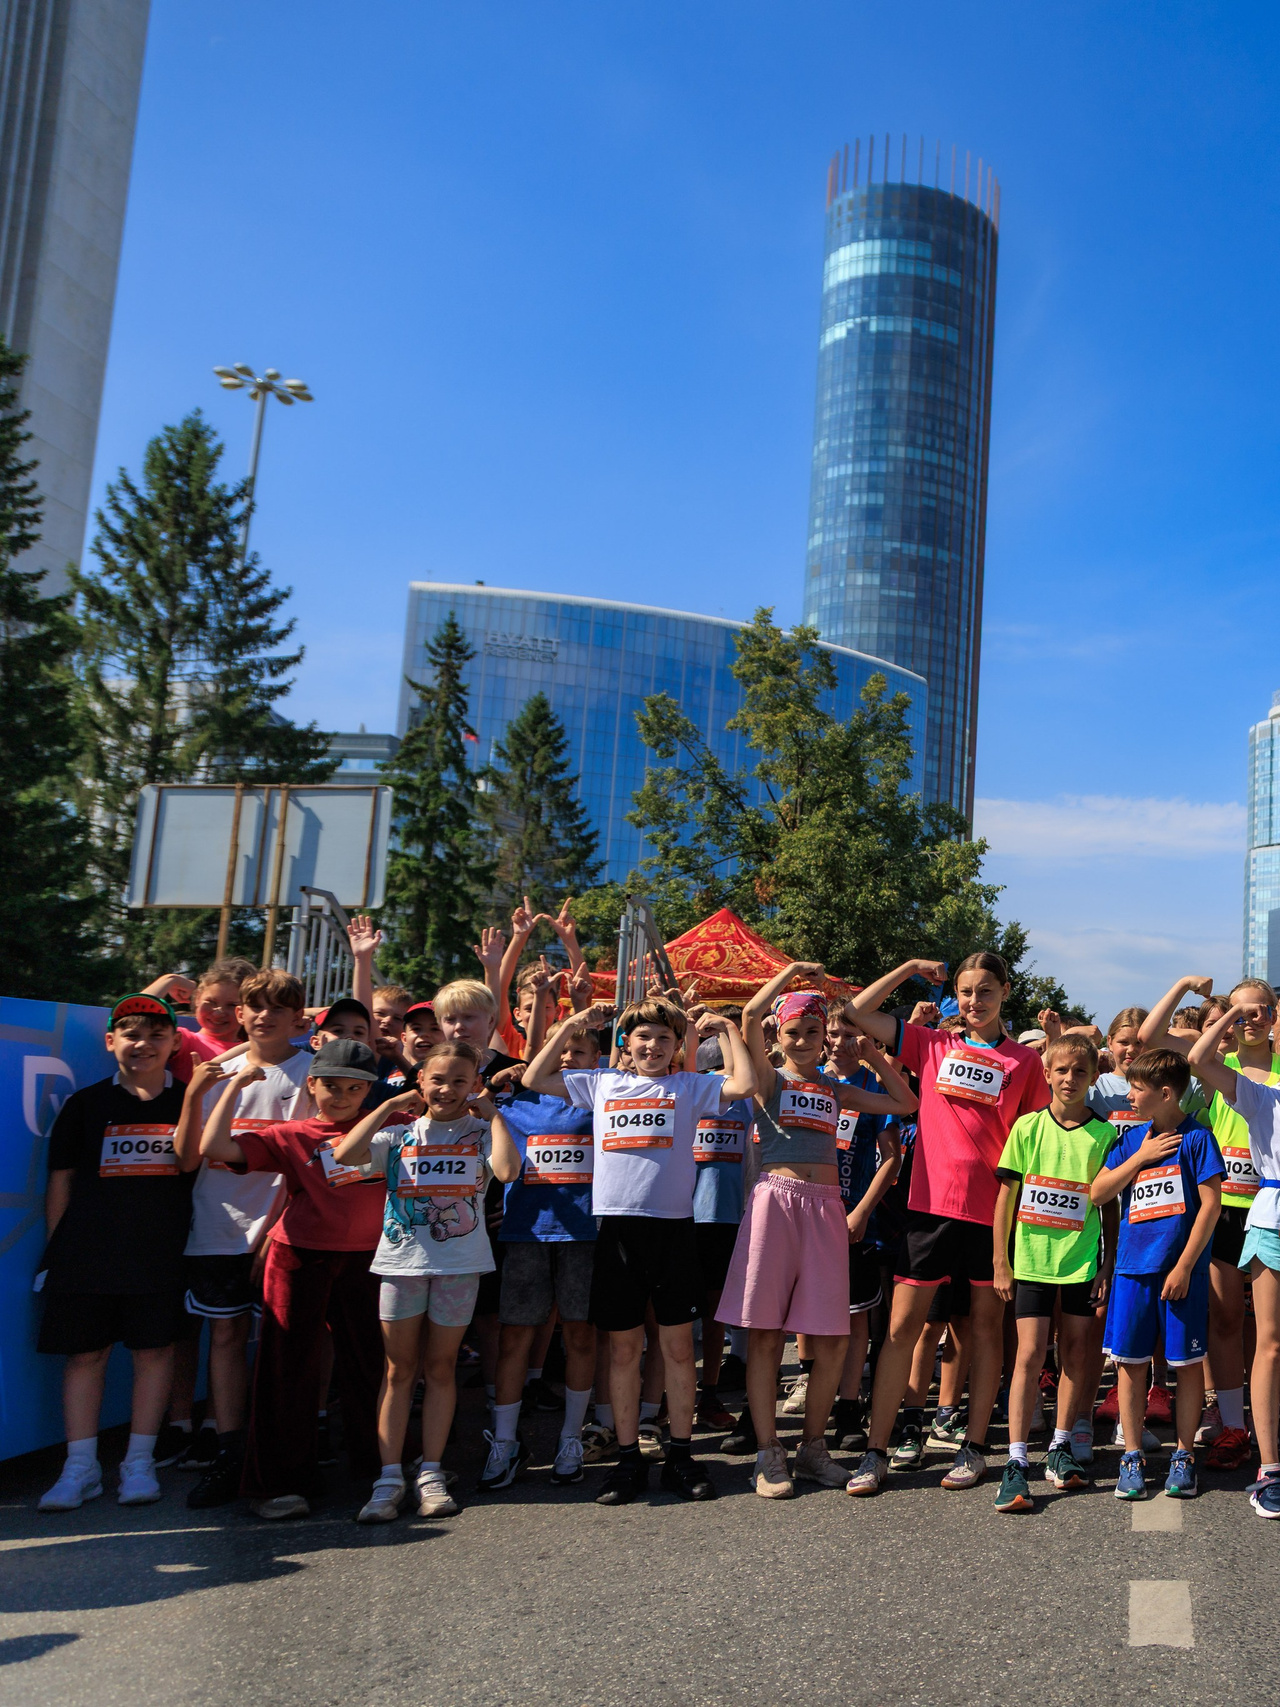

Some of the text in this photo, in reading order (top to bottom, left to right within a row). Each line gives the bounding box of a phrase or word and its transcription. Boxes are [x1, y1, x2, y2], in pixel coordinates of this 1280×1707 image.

[485, 631, 561, 653] HYATT
[484, 646, 558, 663] REGENCY
[948, 1063, 994, 1084] 10159
[790, 1094, 833, 1114] 10158
[609, 1113, 666, 1129] 10486
[110, 1140, 175, 1154] 10062
[698, 1132, 738, 1145] 10371
[534, 1149, 585, 1164] 10129
[410, 1160, 466, 1176] 10412
[1030, 1189, 1080, 1210] 10325
[1132, 1181, 1175, 1202] 10376
